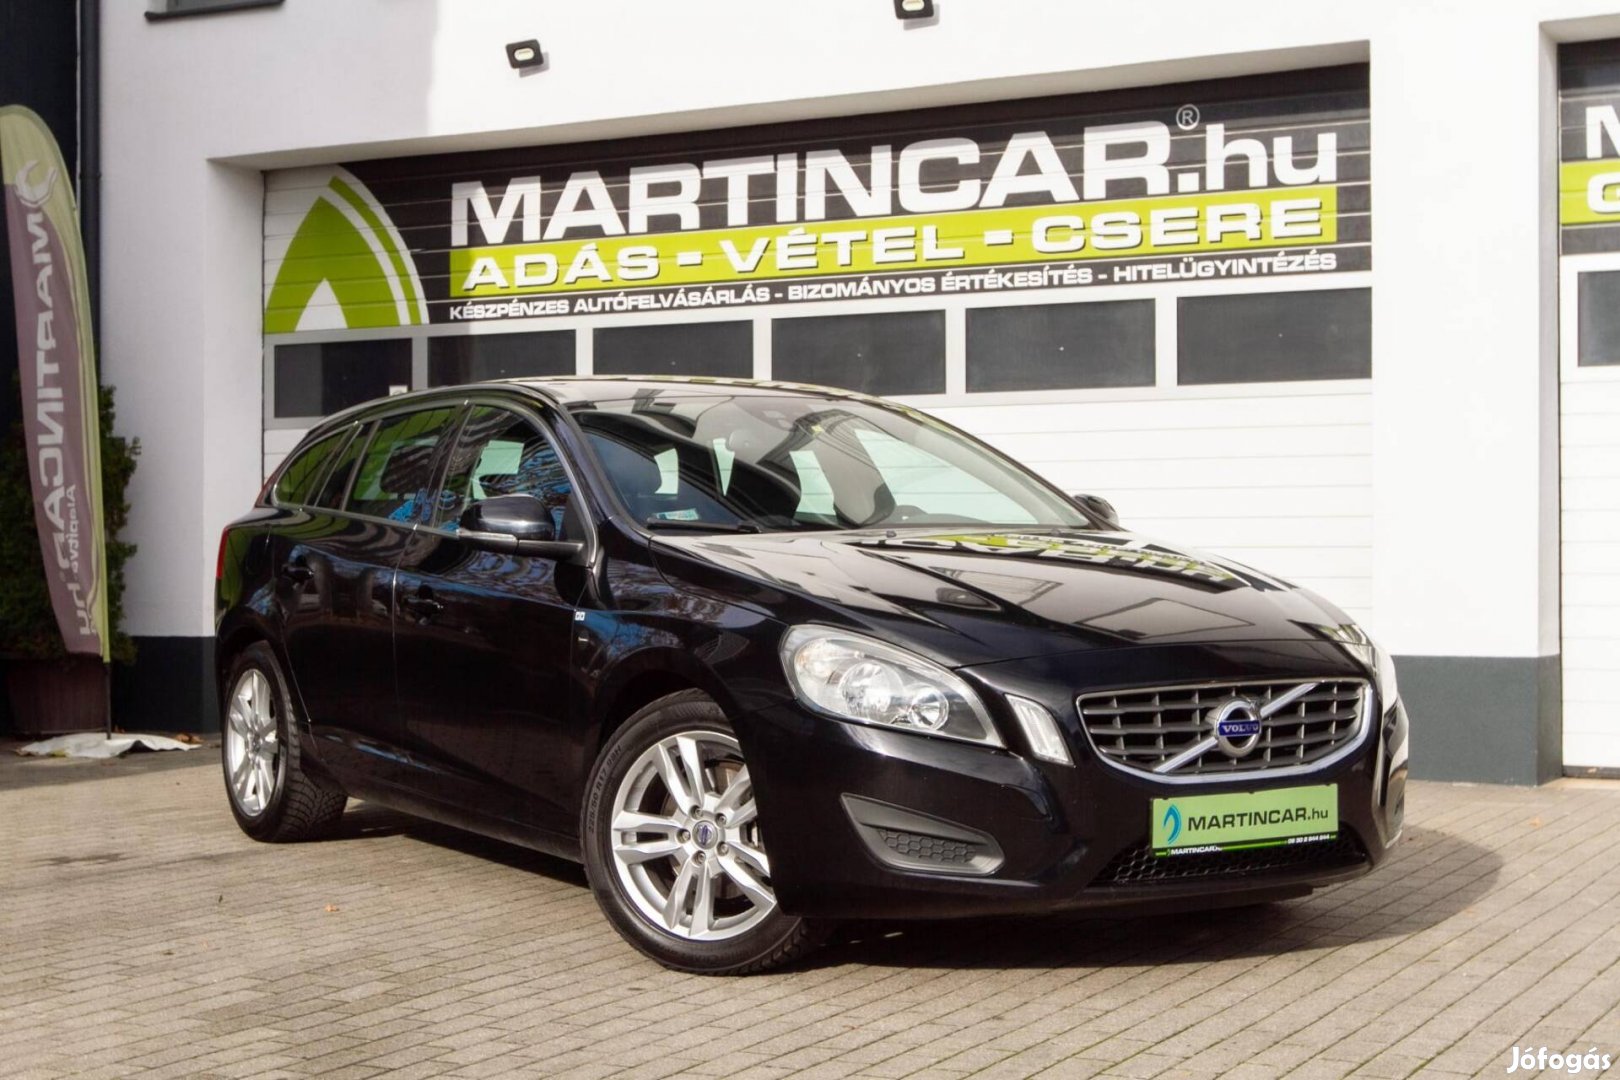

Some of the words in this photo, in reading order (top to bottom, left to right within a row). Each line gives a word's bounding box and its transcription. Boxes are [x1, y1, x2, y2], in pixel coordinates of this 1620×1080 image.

[450, 123, 1337, 247] MARTINCAR.hu
[462, 242, 660, 291] ADÁS
[719, 225, 965, 274] VÉTEL
[1031, 198, 1323, 253] CSERE
[450, 297, 570, 321] KÉSZPÉNZES
[573, 284, 770, 314] AUTÓFELVÁSÁRLÁS
[788, 275, 936, 302] BIZOMÁNYOS
[941, 264, 1093, 293] ÉRTÉKESÍTÉS
[1113, 249, 1337, 283] HITELÜGYINTÉZÉS
[1222, 723, 1259, 733] VOLVO
[1187, 807, 1330, 832] MARTINCAR.hu
